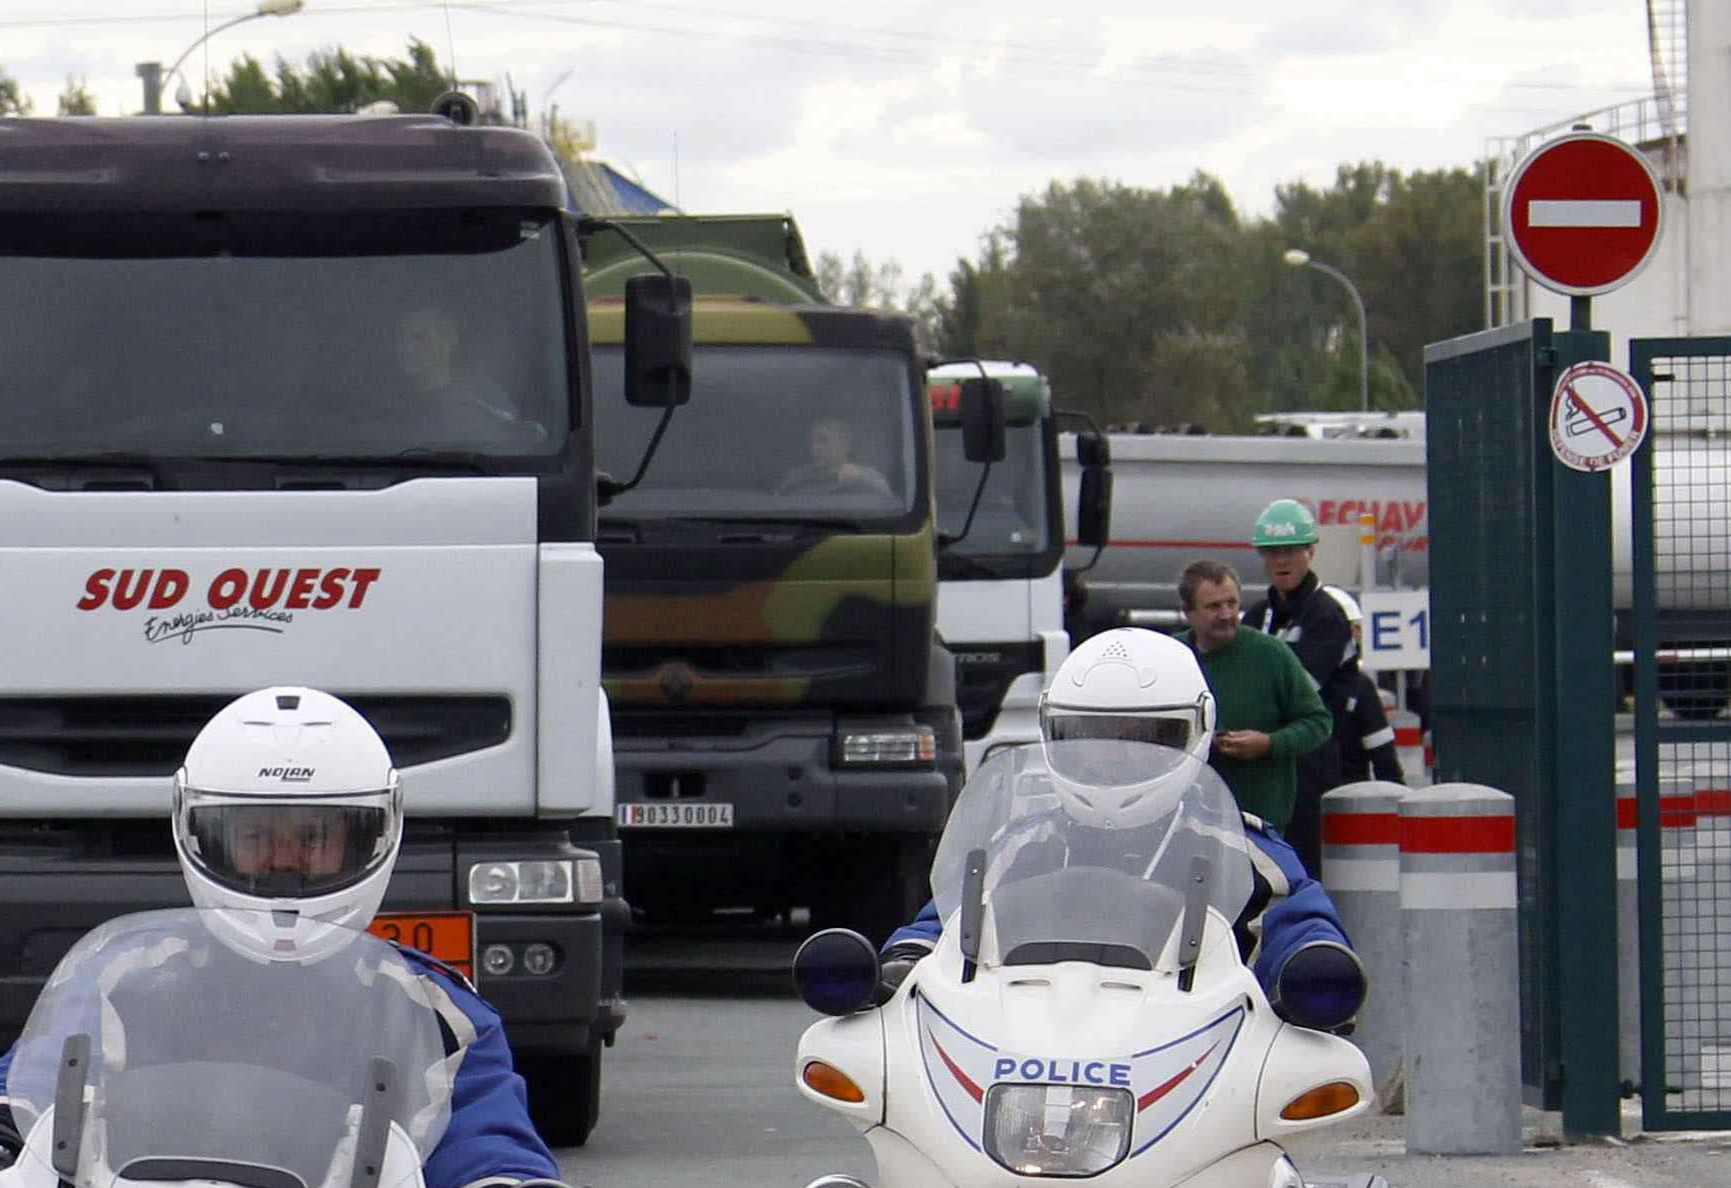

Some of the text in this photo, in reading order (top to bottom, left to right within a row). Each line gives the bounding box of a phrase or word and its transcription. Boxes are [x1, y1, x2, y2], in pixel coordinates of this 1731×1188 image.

[76, 568, 382, 611] SUD OUEST
[144, 605, 294, 645] Energies Services
[258, 767, 316, 782] NOLAN
[994, 1058, 1131, 1086] POLICE
